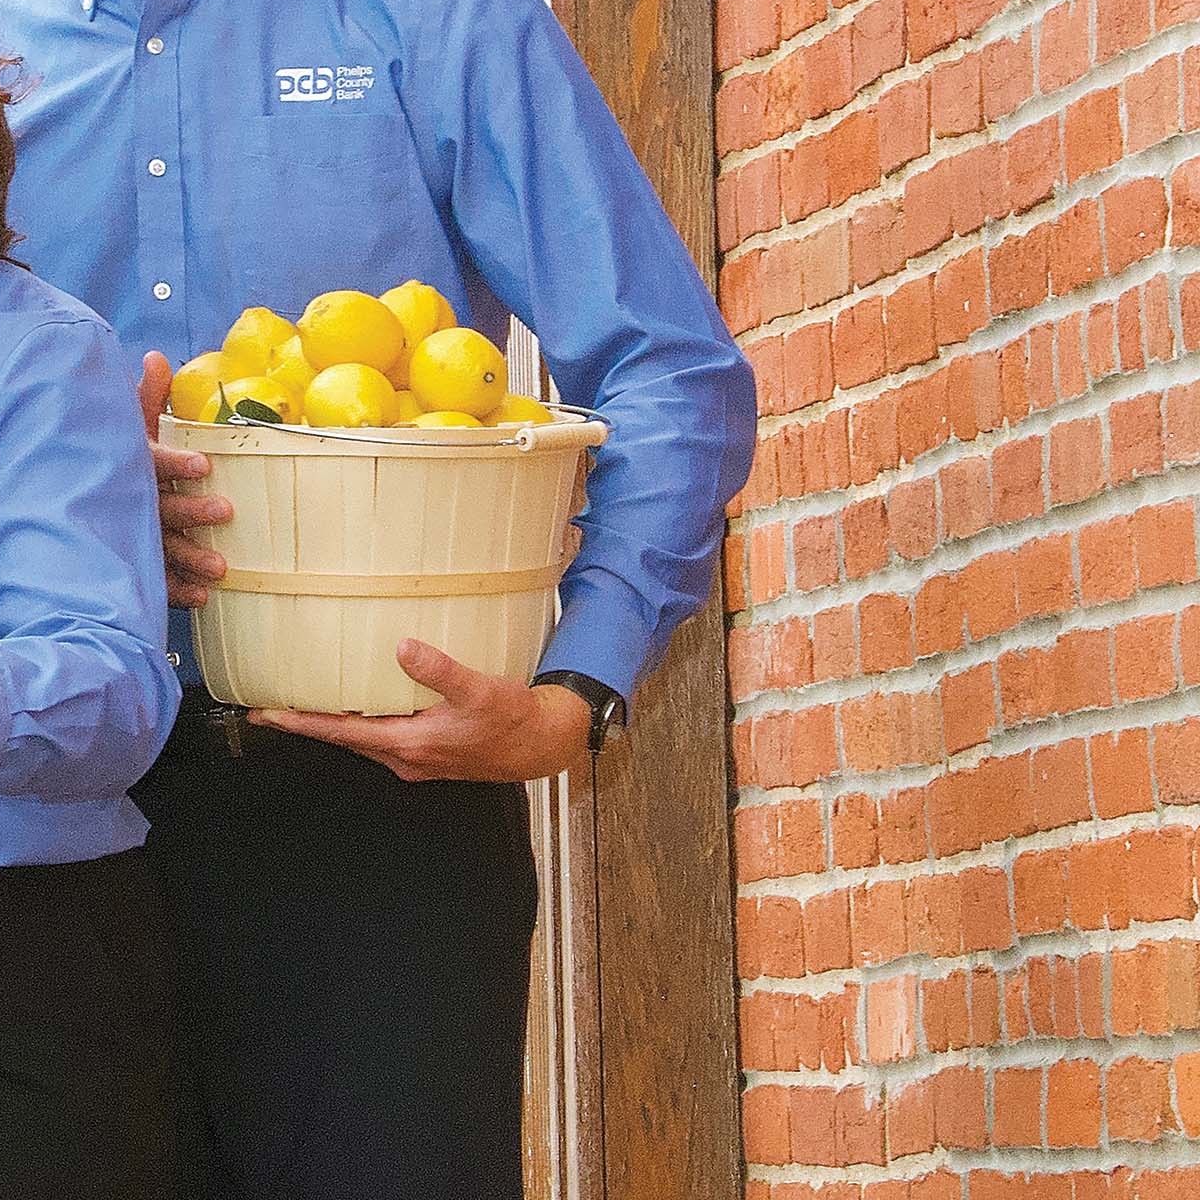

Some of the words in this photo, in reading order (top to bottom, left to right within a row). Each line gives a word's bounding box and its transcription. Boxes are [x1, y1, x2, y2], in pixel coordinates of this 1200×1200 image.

[336, 65, 373, 77] Phelps
[336, 77, 375, 89] County
[336, 89, 365, 100] Bank
